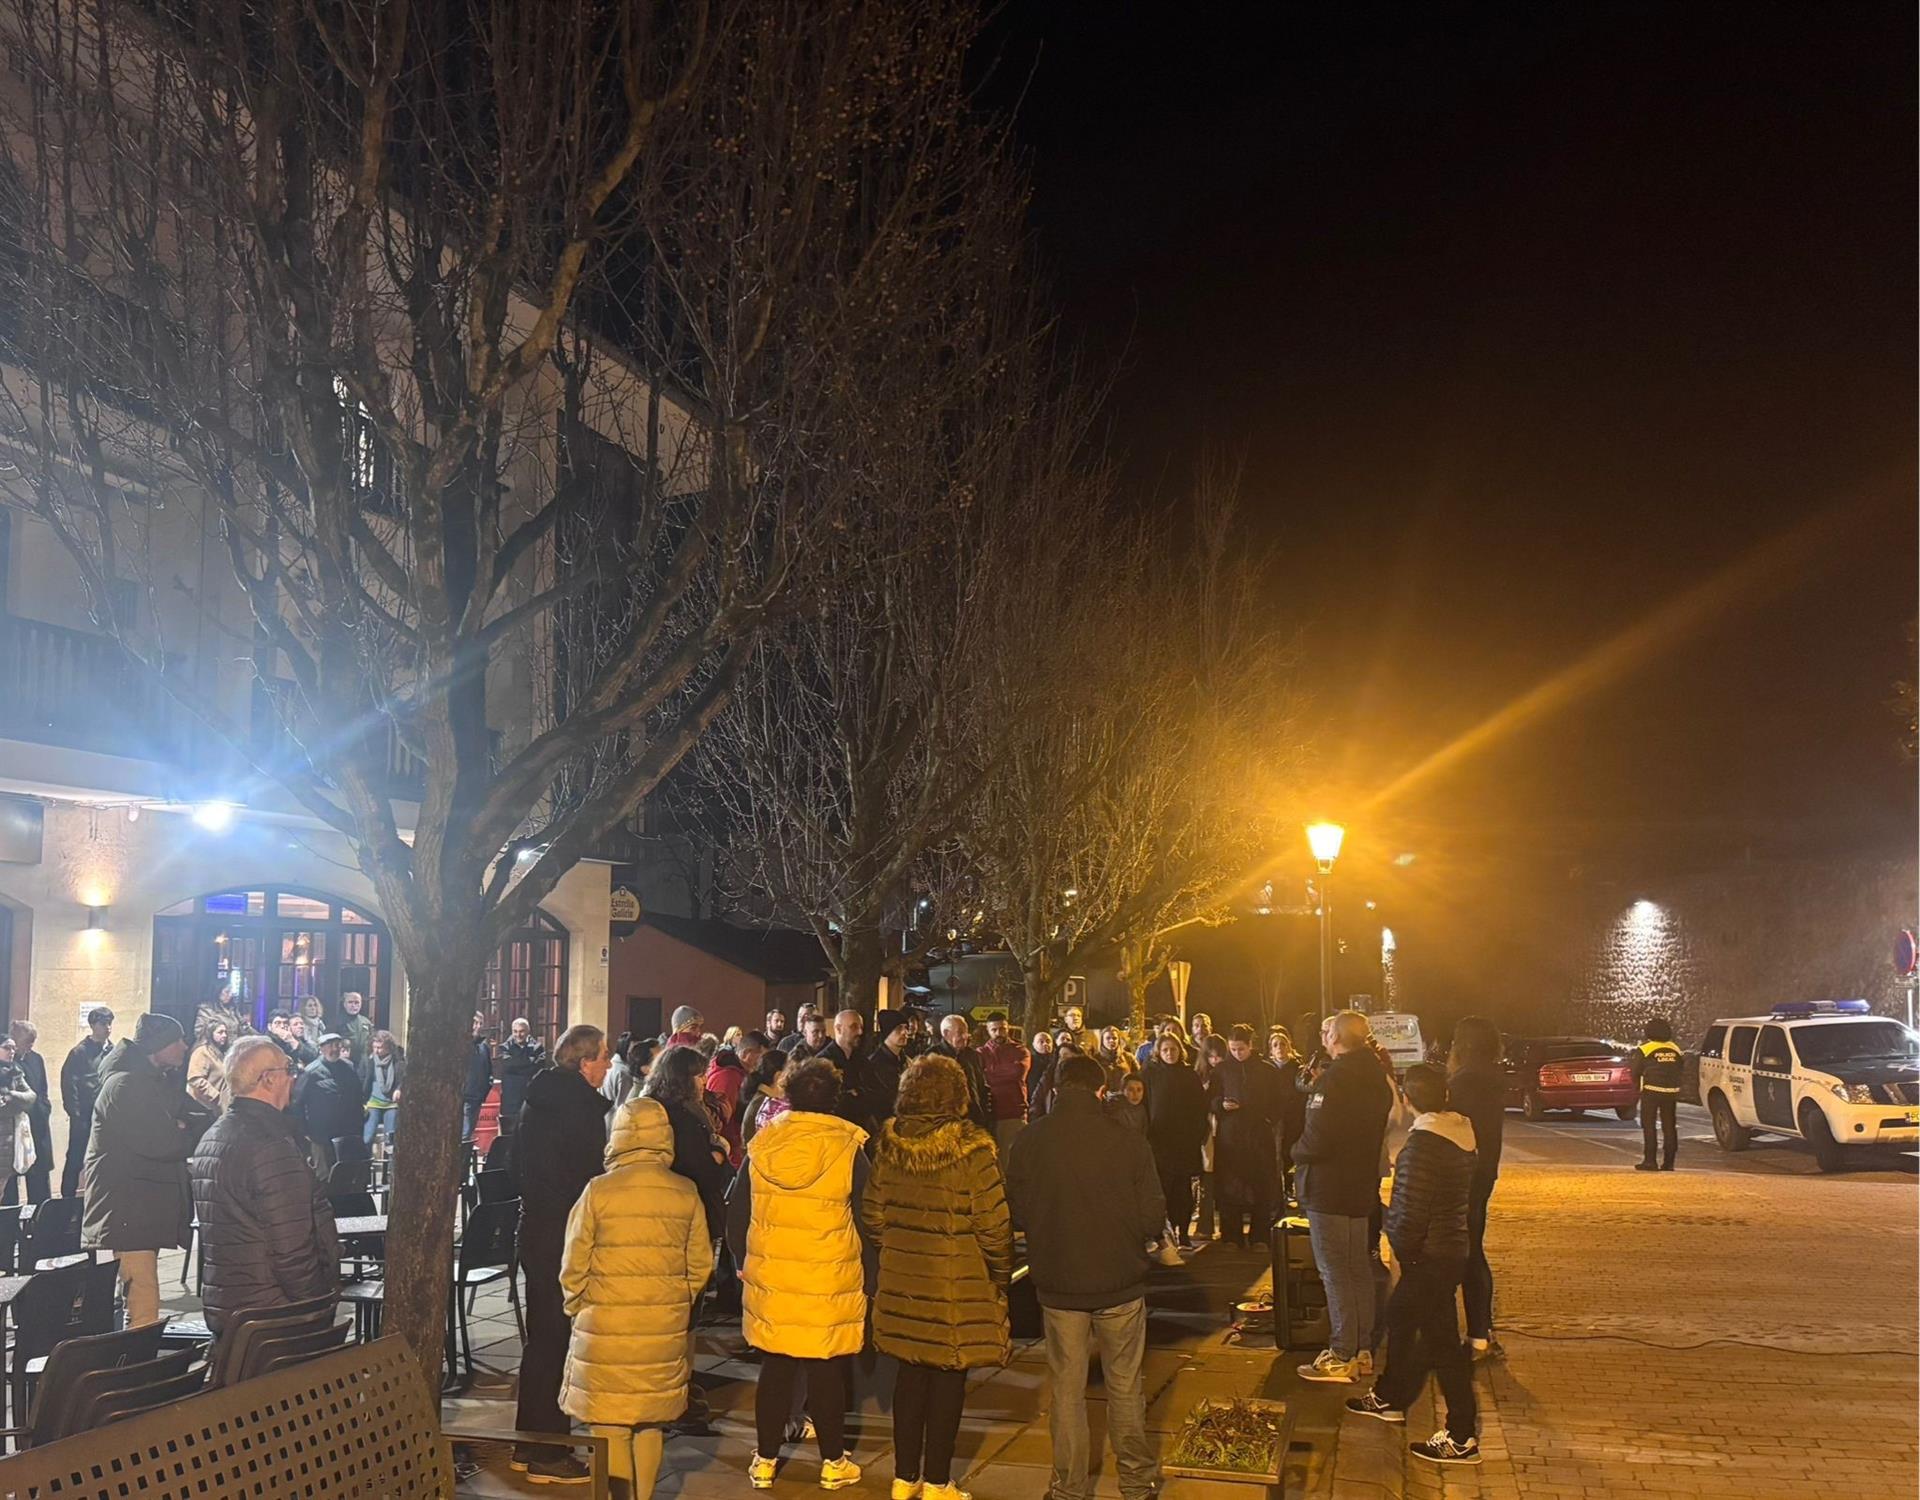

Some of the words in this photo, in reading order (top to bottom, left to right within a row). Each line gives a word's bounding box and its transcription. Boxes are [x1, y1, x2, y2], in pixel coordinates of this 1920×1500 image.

[611, 898, 634, 908] Estrella
[611, 908, 633, 918] Galicia
[1064, 980, 1077, 1002] P
